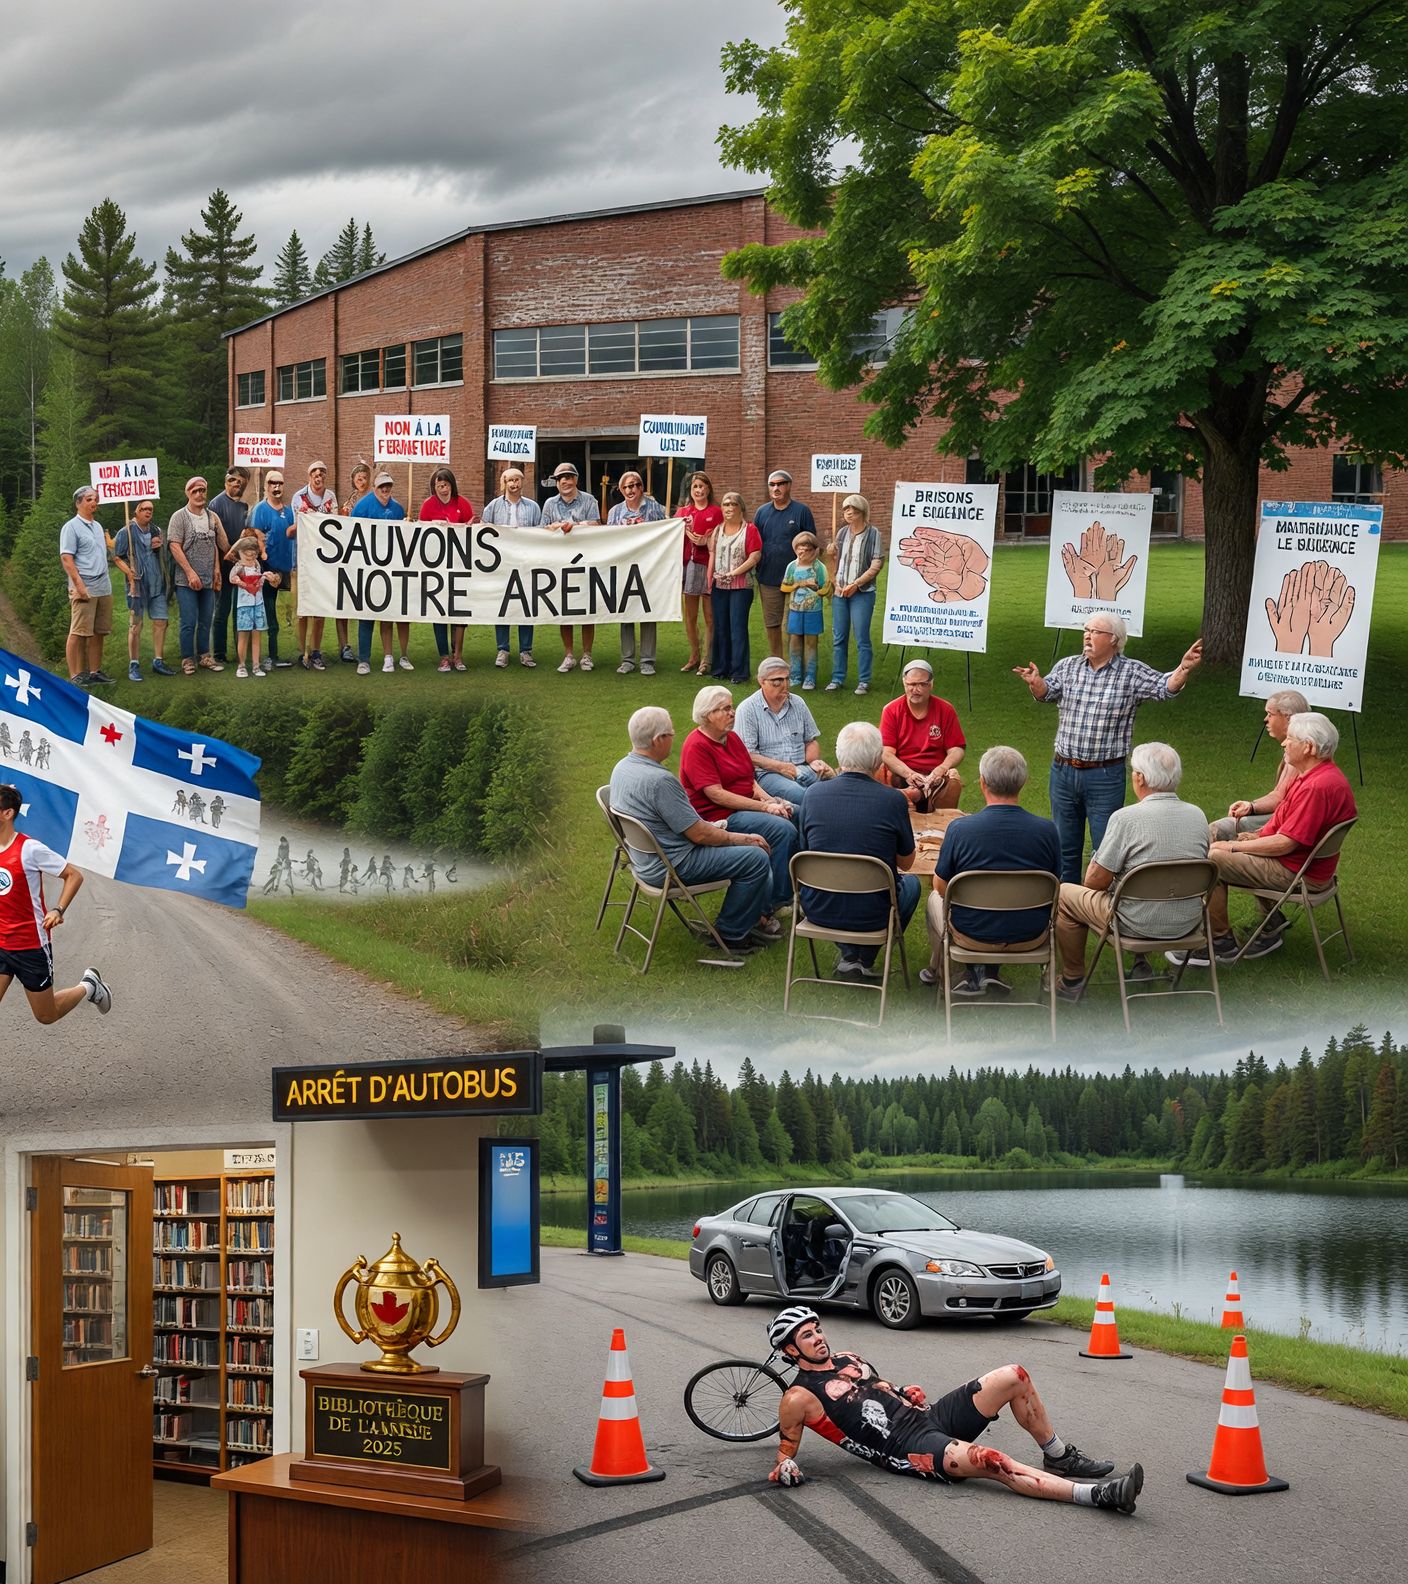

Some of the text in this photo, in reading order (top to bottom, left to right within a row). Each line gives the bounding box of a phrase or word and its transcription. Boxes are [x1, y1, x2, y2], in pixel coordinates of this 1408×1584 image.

[385, 421, 410, 436] NON
[427, 422, 442, 436] LA
[915, 490, 974, 504] BRISONS
[901, 504, 916, 517] LE
[316, 519, 502, 573] SAUVONS
[1277, 538, 1293, 550] LE
[336, 553, 652, 618] NOTRE ARÉNA
[286, 1067, 518, 1107] ARRÊT D'AUTOBUS
[329, 1416, 351, 1432] DE
[363, 1439, 402, 1457] 2025
